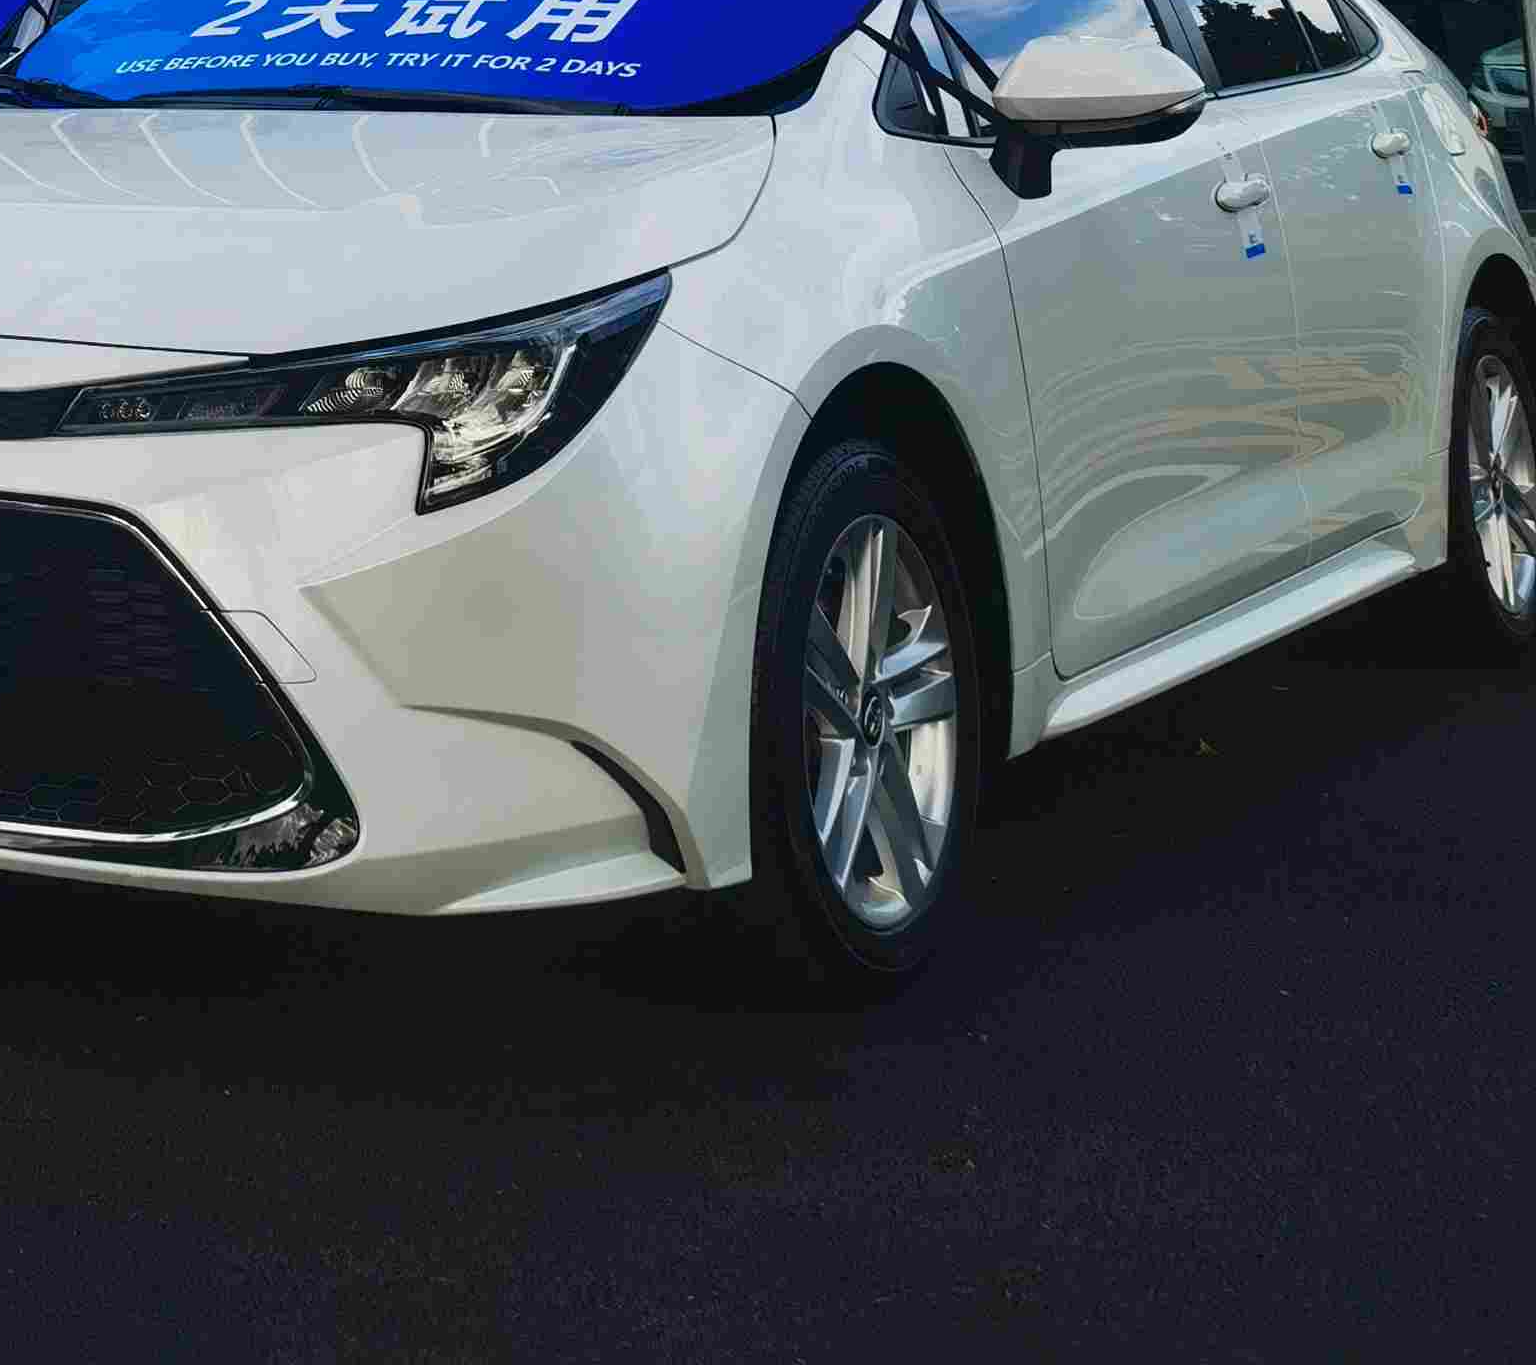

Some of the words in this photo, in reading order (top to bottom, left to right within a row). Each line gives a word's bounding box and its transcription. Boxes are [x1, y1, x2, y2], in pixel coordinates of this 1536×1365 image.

[114, 60, 166, 75] USE
[165, 54, 260, 71] BEFORE
[260, 52, 318, 68] YOU
[319, 52, 375, 69] BUY,
[386, 52, 438, 67] TRY
[439, 53, 470, 68] IT
[473, 54, 531, 71] FOR
[534, 57, 557, 73] 2
[560, 58, 642, 78] DAYS
